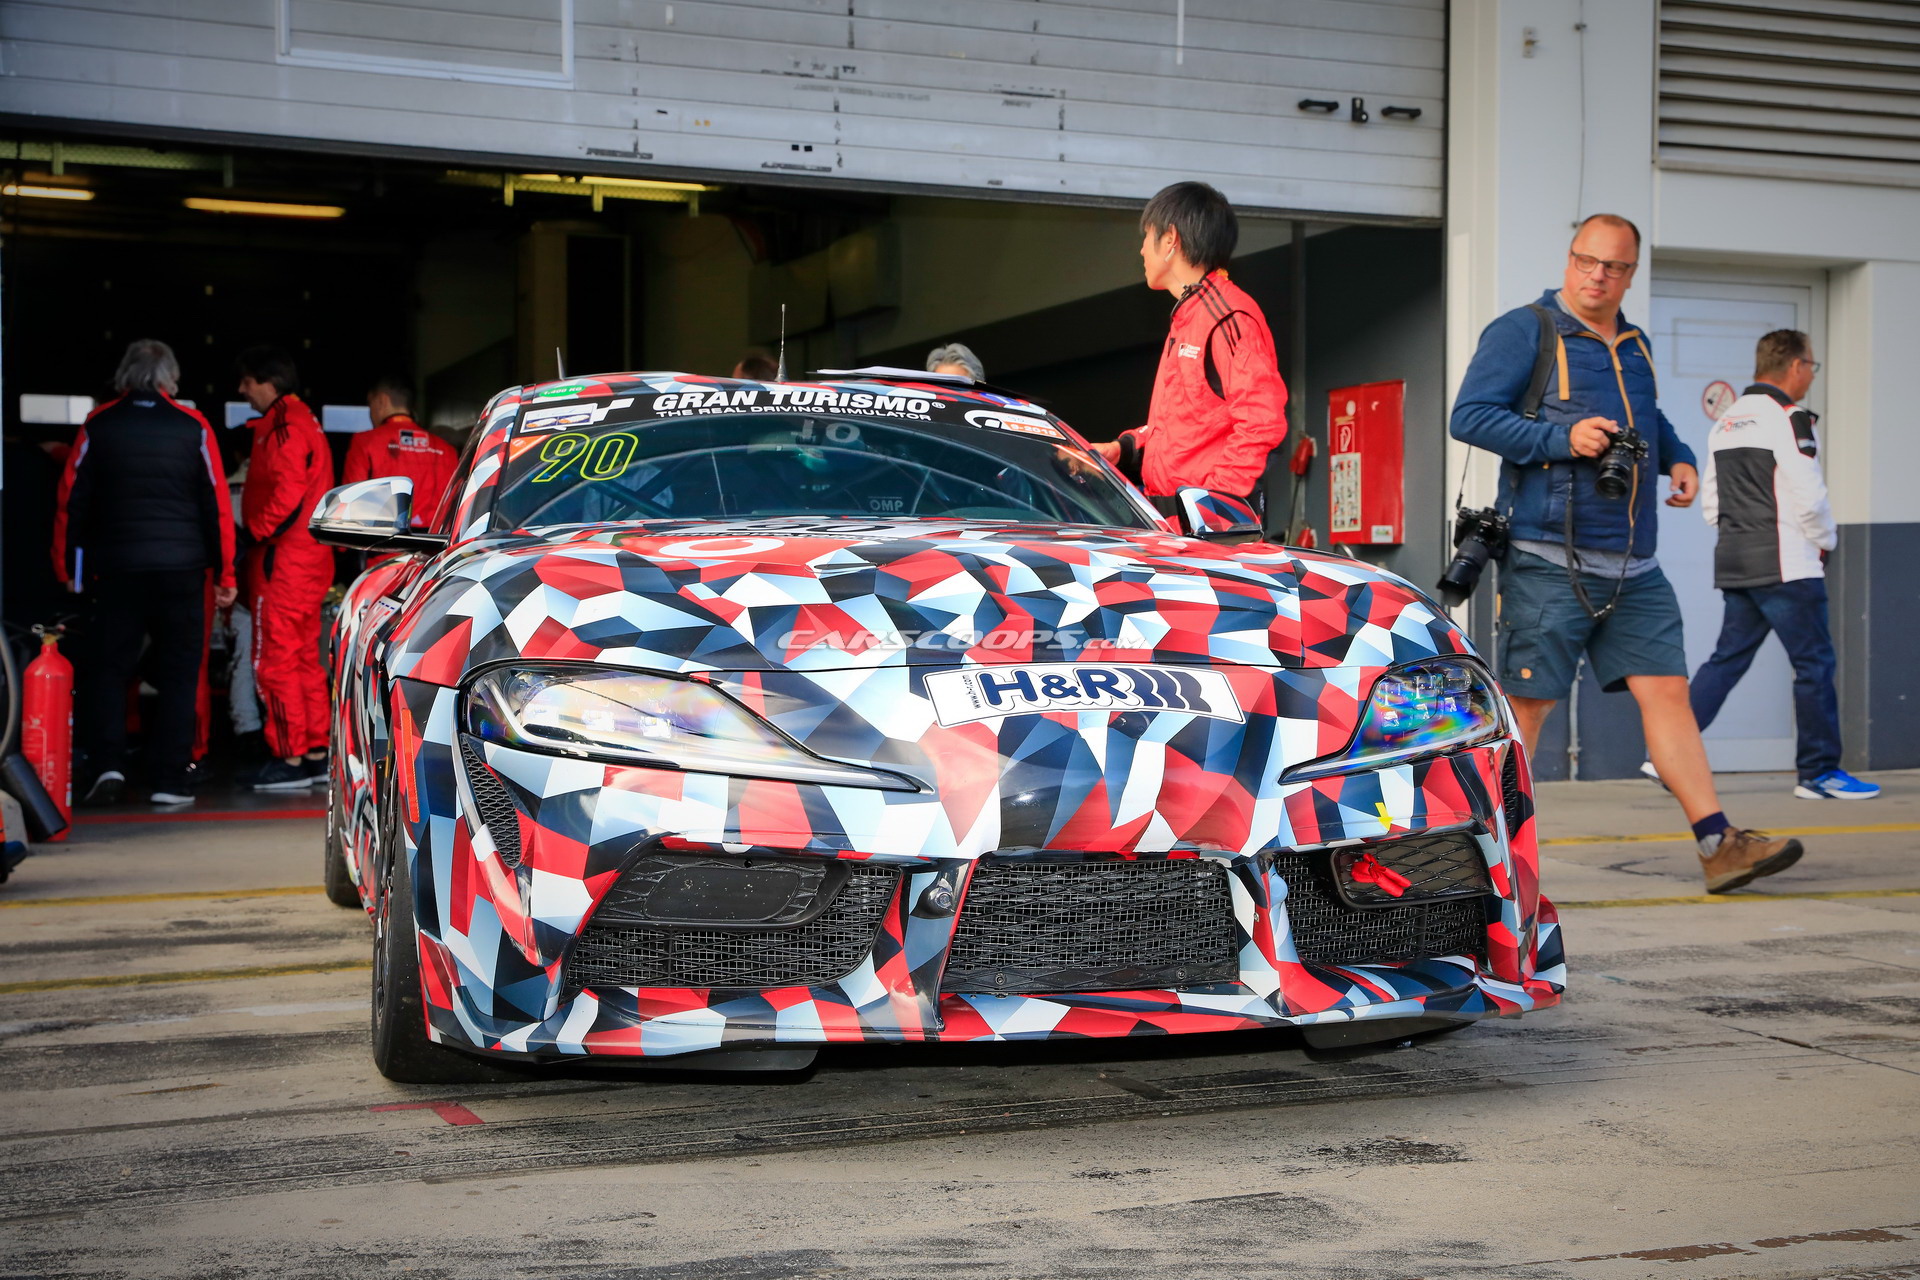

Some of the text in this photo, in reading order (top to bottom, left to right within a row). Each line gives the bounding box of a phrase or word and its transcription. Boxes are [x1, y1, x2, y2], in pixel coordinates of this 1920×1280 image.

[652, 390, 759, 411] GRAN
[656, 405, 932, 421] THE REAL DRIVING SIMULATOR
[531, 432, 639, 483] 90
[869, 499, 904, 513] OMP
[979, 668, 1129, 706] H&R
